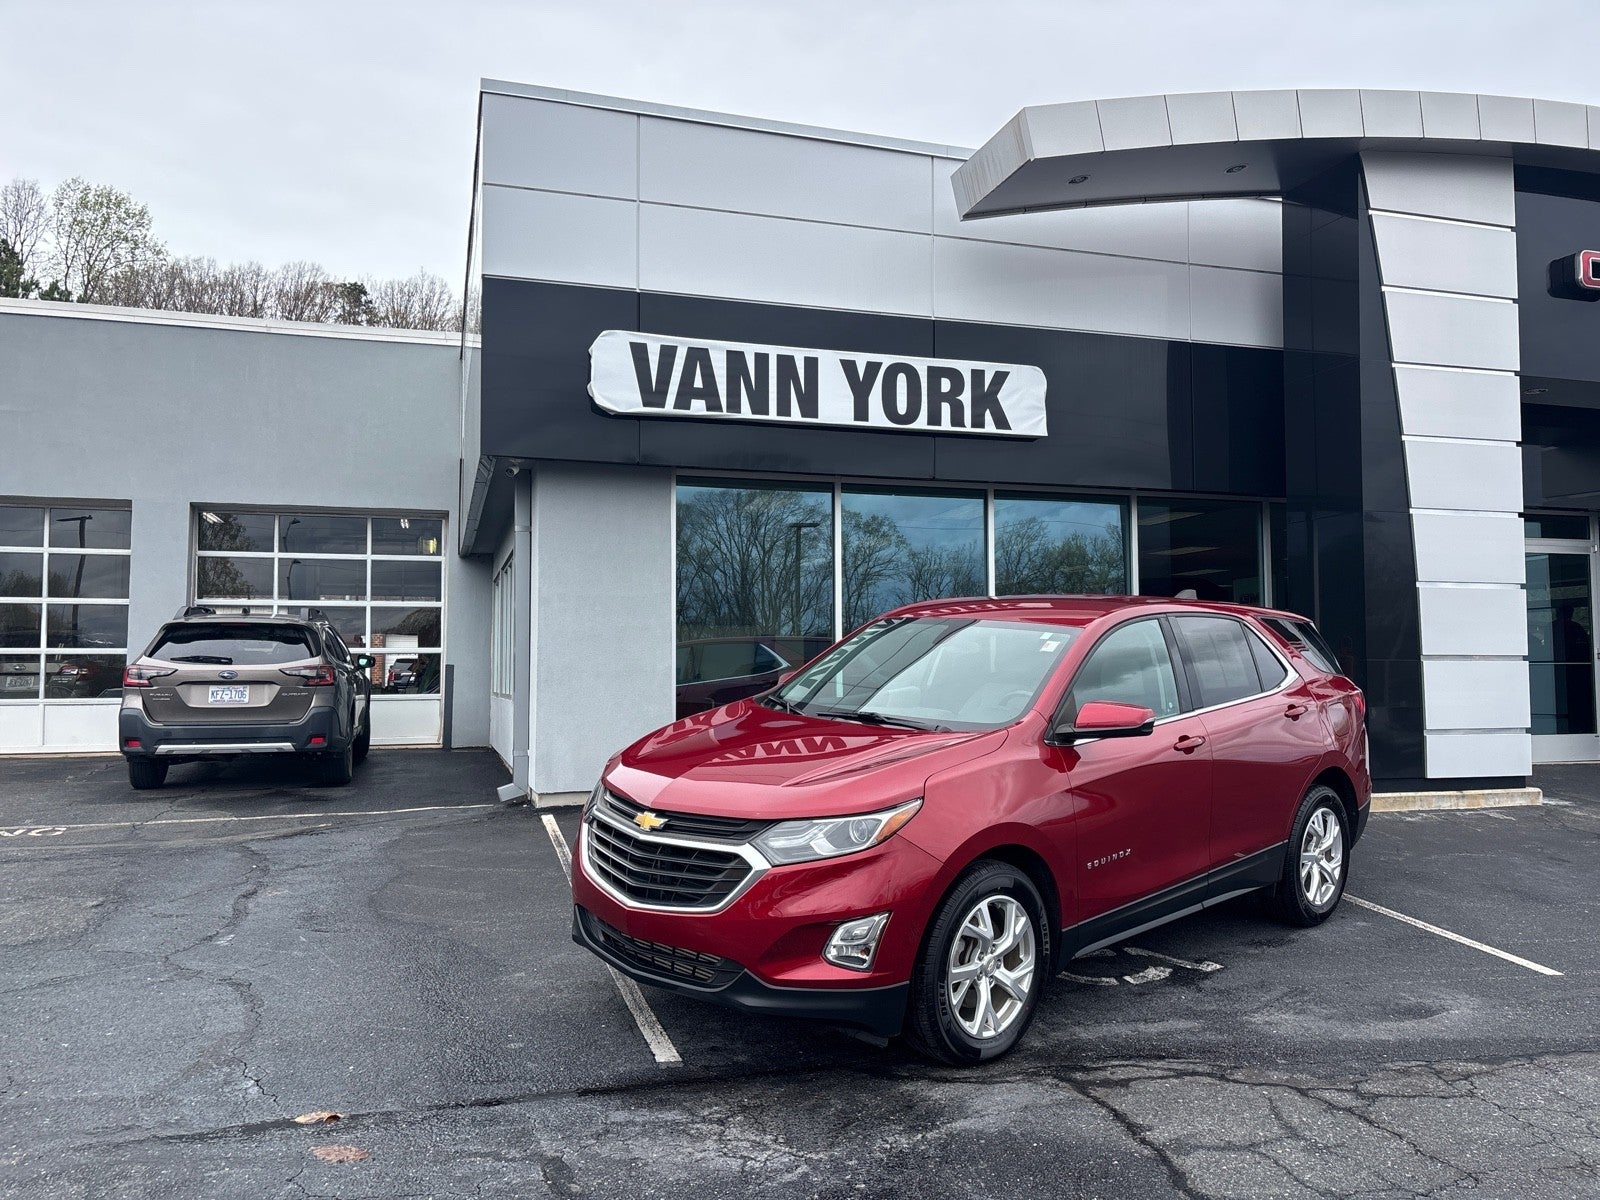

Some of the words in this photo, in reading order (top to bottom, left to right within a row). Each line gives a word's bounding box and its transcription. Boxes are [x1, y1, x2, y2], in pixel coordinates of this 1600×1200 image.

[628, 341, 819, 419] VANN
[838, 358, 1012, 431] YORK
[210, 690, 247, 700] KFZ-1706
